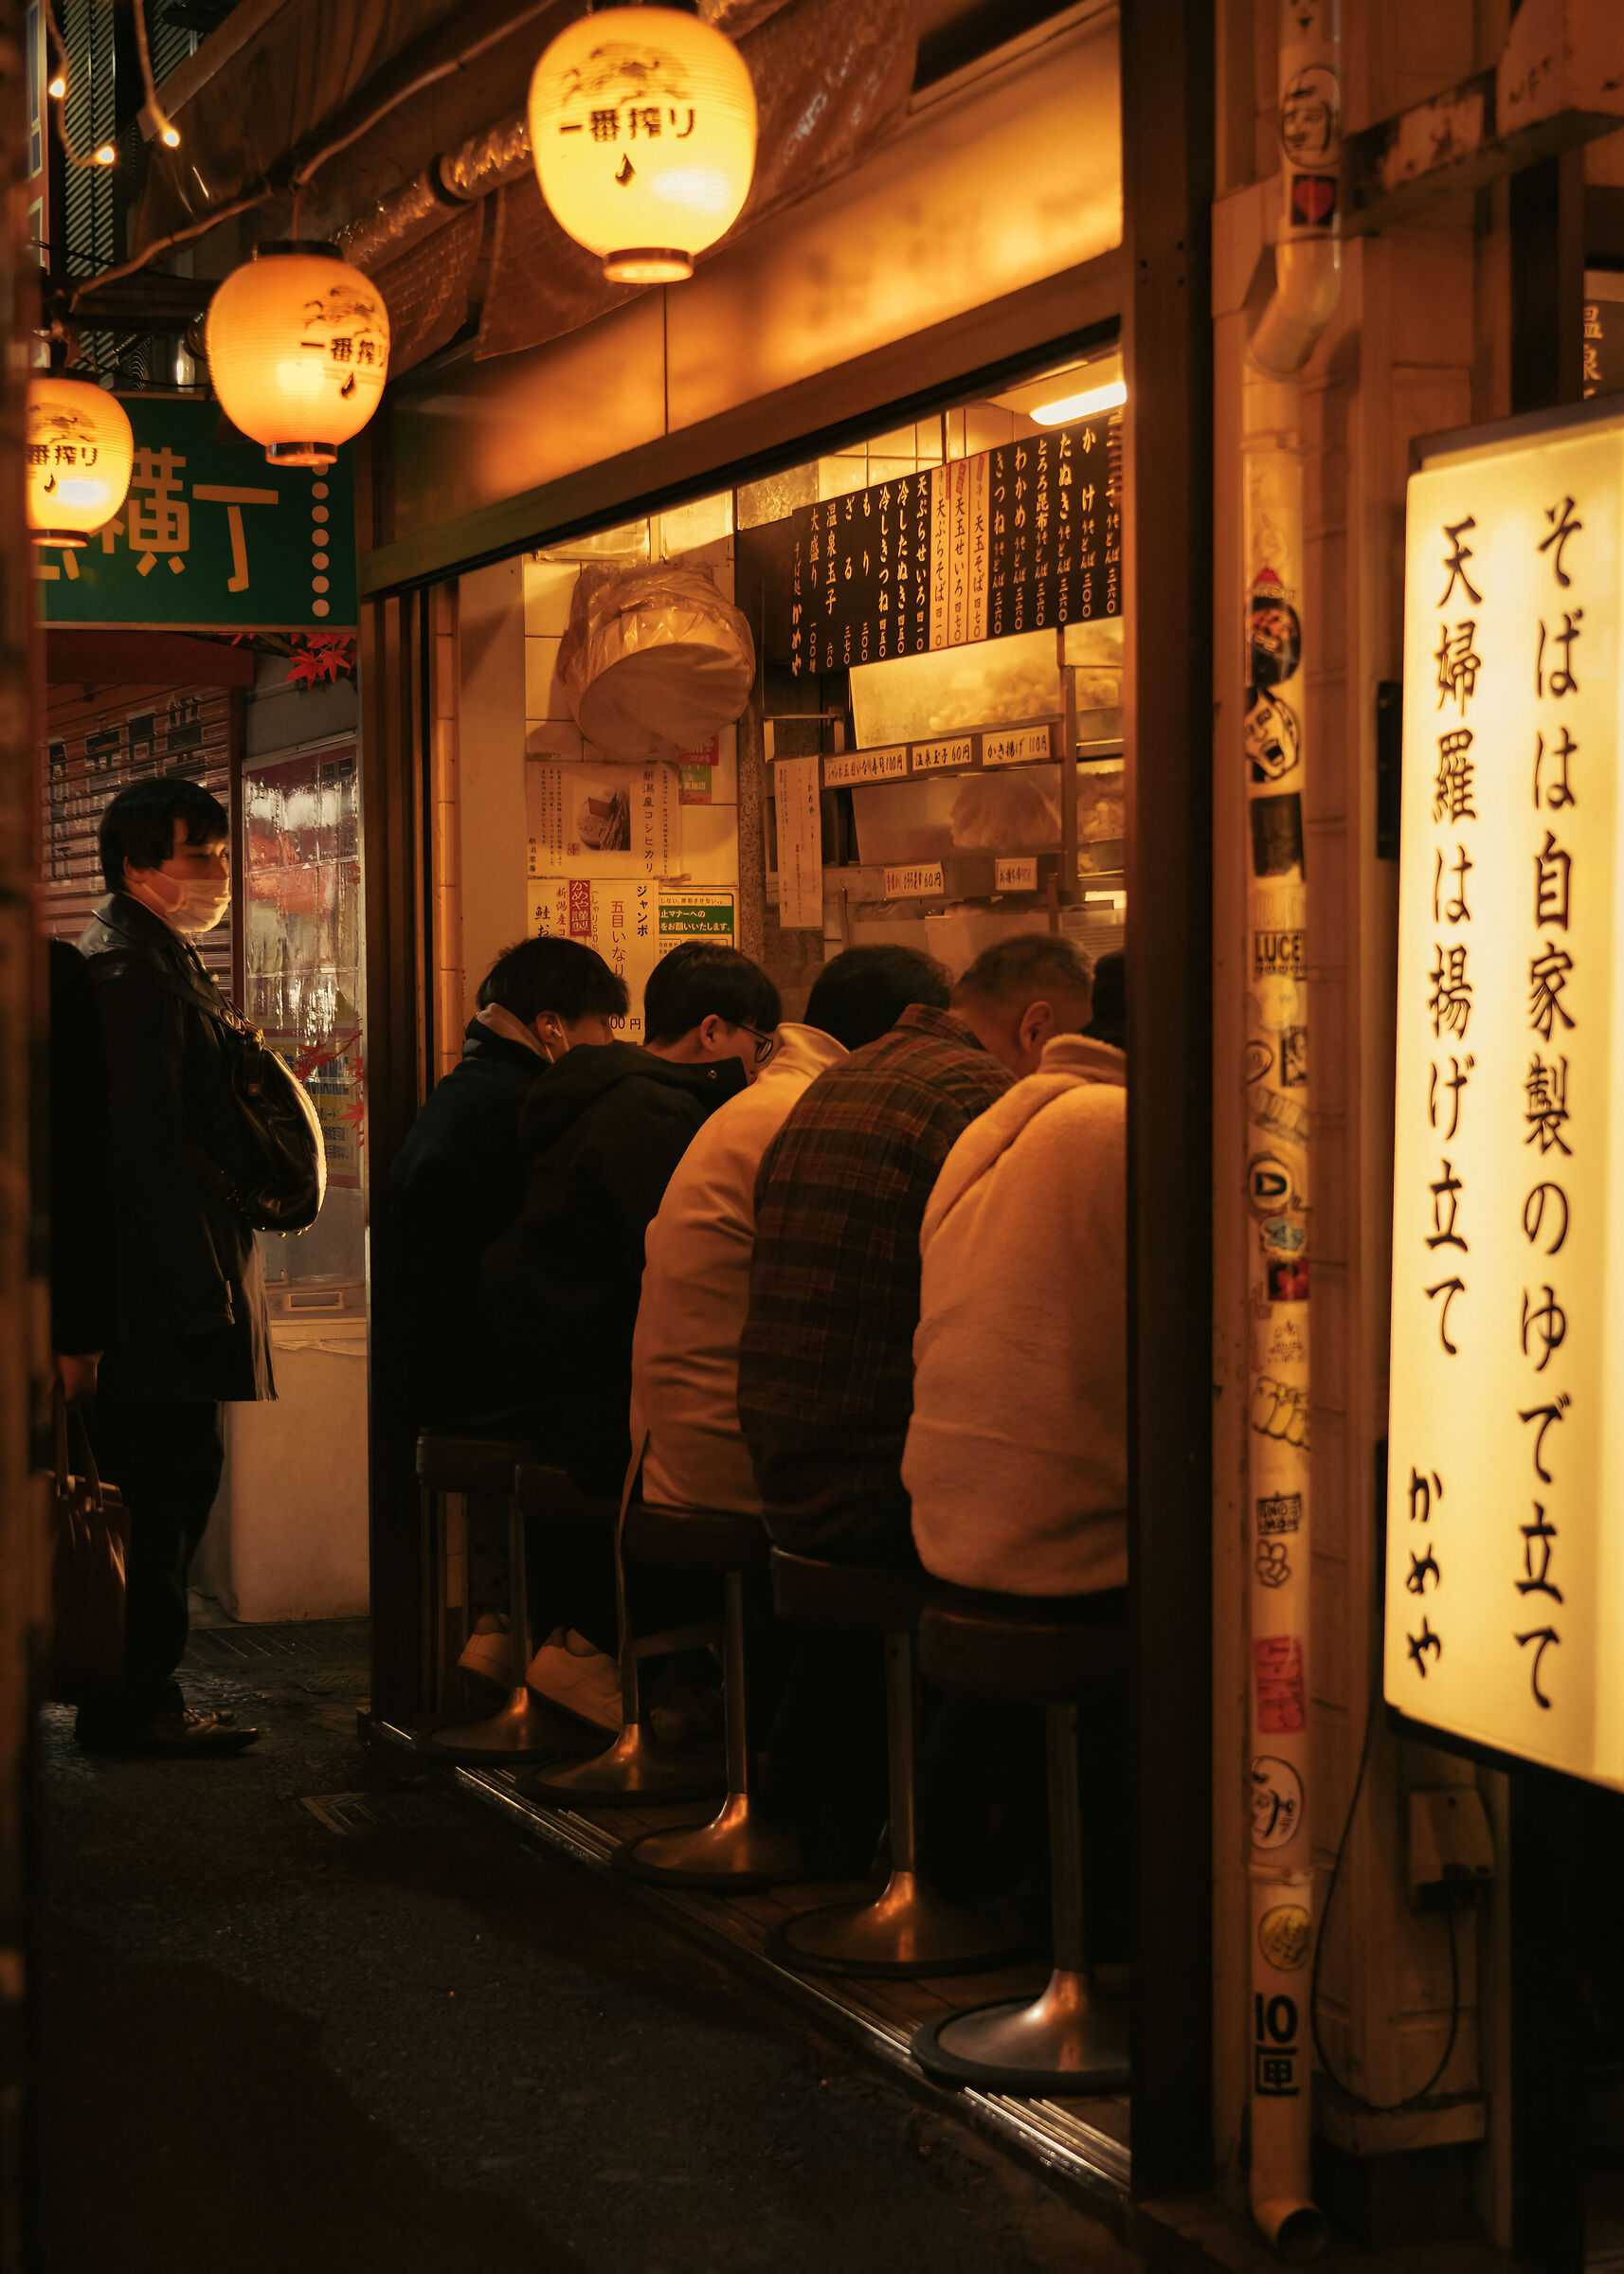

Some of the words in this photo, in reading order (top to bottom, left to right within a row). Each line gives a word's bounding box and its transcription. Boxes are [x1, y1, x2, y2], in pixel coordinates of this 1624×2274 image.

[559, 107, 696, 142] 一番搾り
[994, 451, 1005, 535] きつね
[1015, 446, 1027, 529] わかめ
[1058, 431, 1074, 521] たぬき
[1082, 426, 1097, 513] かけ
[810, 507, 820, 588] 大盛り
[825, 502, 838, 615] 温泉玉子
[844, 496, 856, 581] ざる
[862, 492, 871, 577] もり
[878, 484, 891, 613] 冷しきつね
[896, 479, 910, 610] 冷したぬき
[915, 475, 929, 606] 天ぷらせいろ
[951, 744, 970, 762] 60円
[611, 901, 626, 978] 五目いなり
[637, 885, 648, 937] ジャンボ
[1423, 515, 1482, 1355] 天婦羅は揚げ立て
[1512, 496, 1583, 1708] そばは自家製のゆで立て
[1406, 1465, 1442, 1679] かめや
[1254, 1992, 1298, 2043] 10
